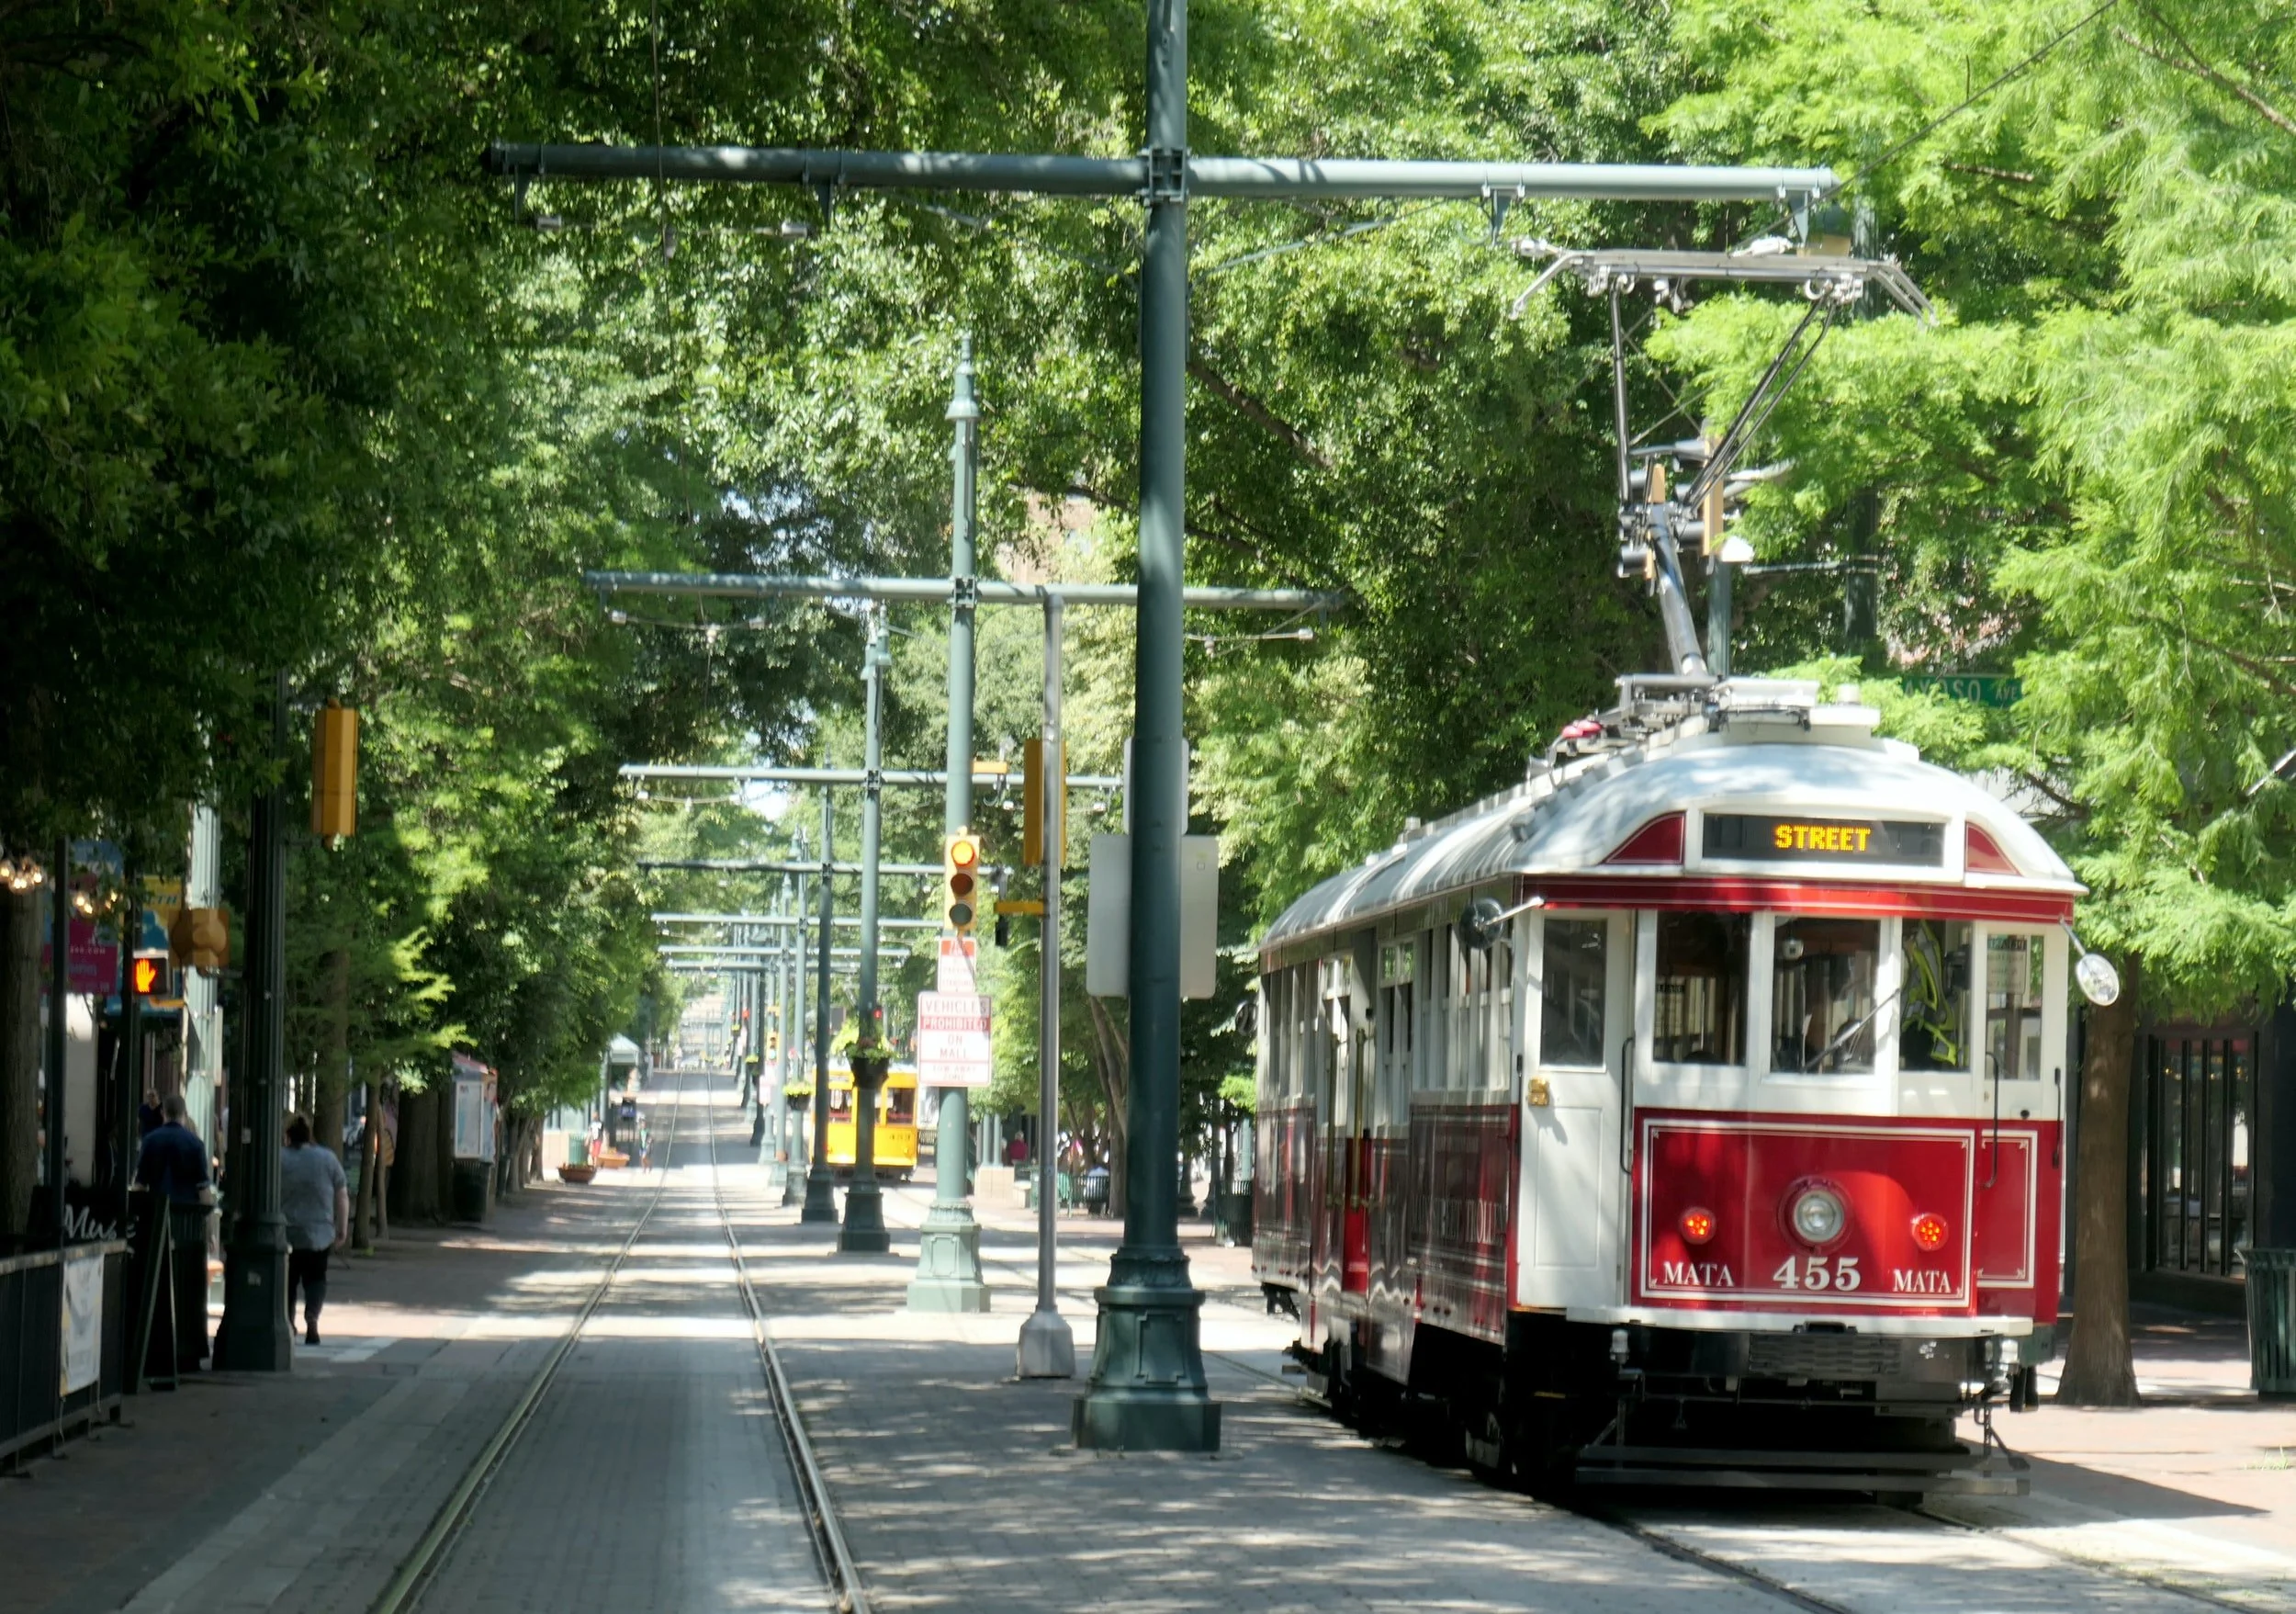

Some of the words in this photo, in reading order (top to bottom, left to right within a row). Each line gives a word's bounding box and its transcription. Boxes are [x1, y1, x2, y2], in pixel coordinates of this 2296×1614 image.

[1903, 678, 1982, 705] AYOSO
[1995, 684, 2018, 701] AVE
[1773, 824, 1872, 852] STREET
[925, 999, 987, 1014] VEHICLES
[923, 1017, 987, 1030] PROHIBITED
[947, 1033, 962, 1046] ON
[940, 1047, 968, 1060] MALL
[1662, 1260, 1735, 1288] MATA
[1773, 1256, 1861, 1292] 455
[1892, 1269, 1952, 1293] MATA
